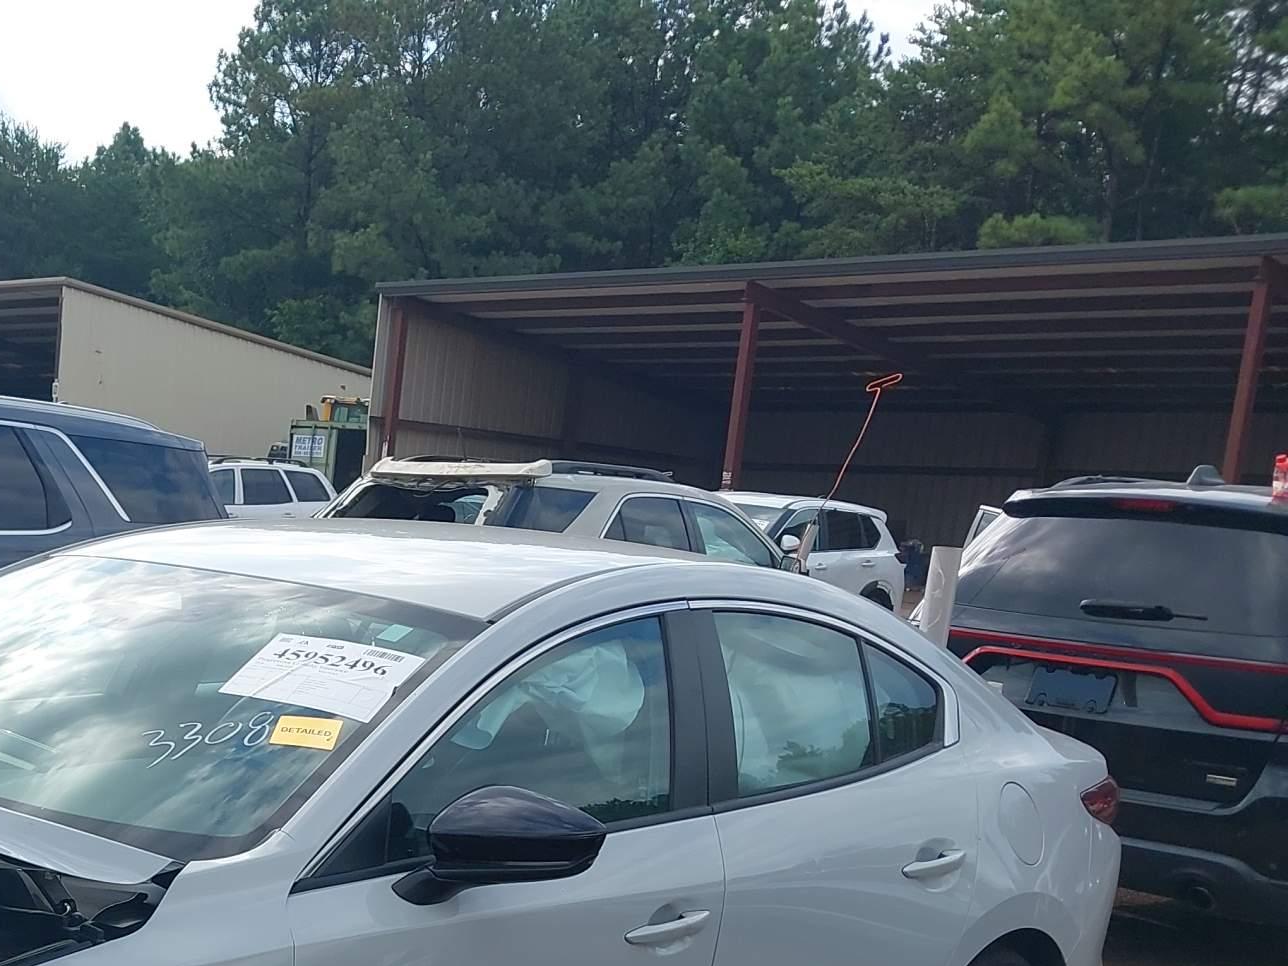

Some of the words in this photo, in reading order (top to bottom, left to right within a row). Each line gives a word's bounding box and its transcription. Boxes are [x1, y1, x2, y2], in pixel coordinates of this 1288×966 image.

[295, 436, 323, 446] METRO
[273, 648, 392, 677] 45952496
[142, 711, 274, 768] 3308
[280, 726, 332, 737] DETAILED
